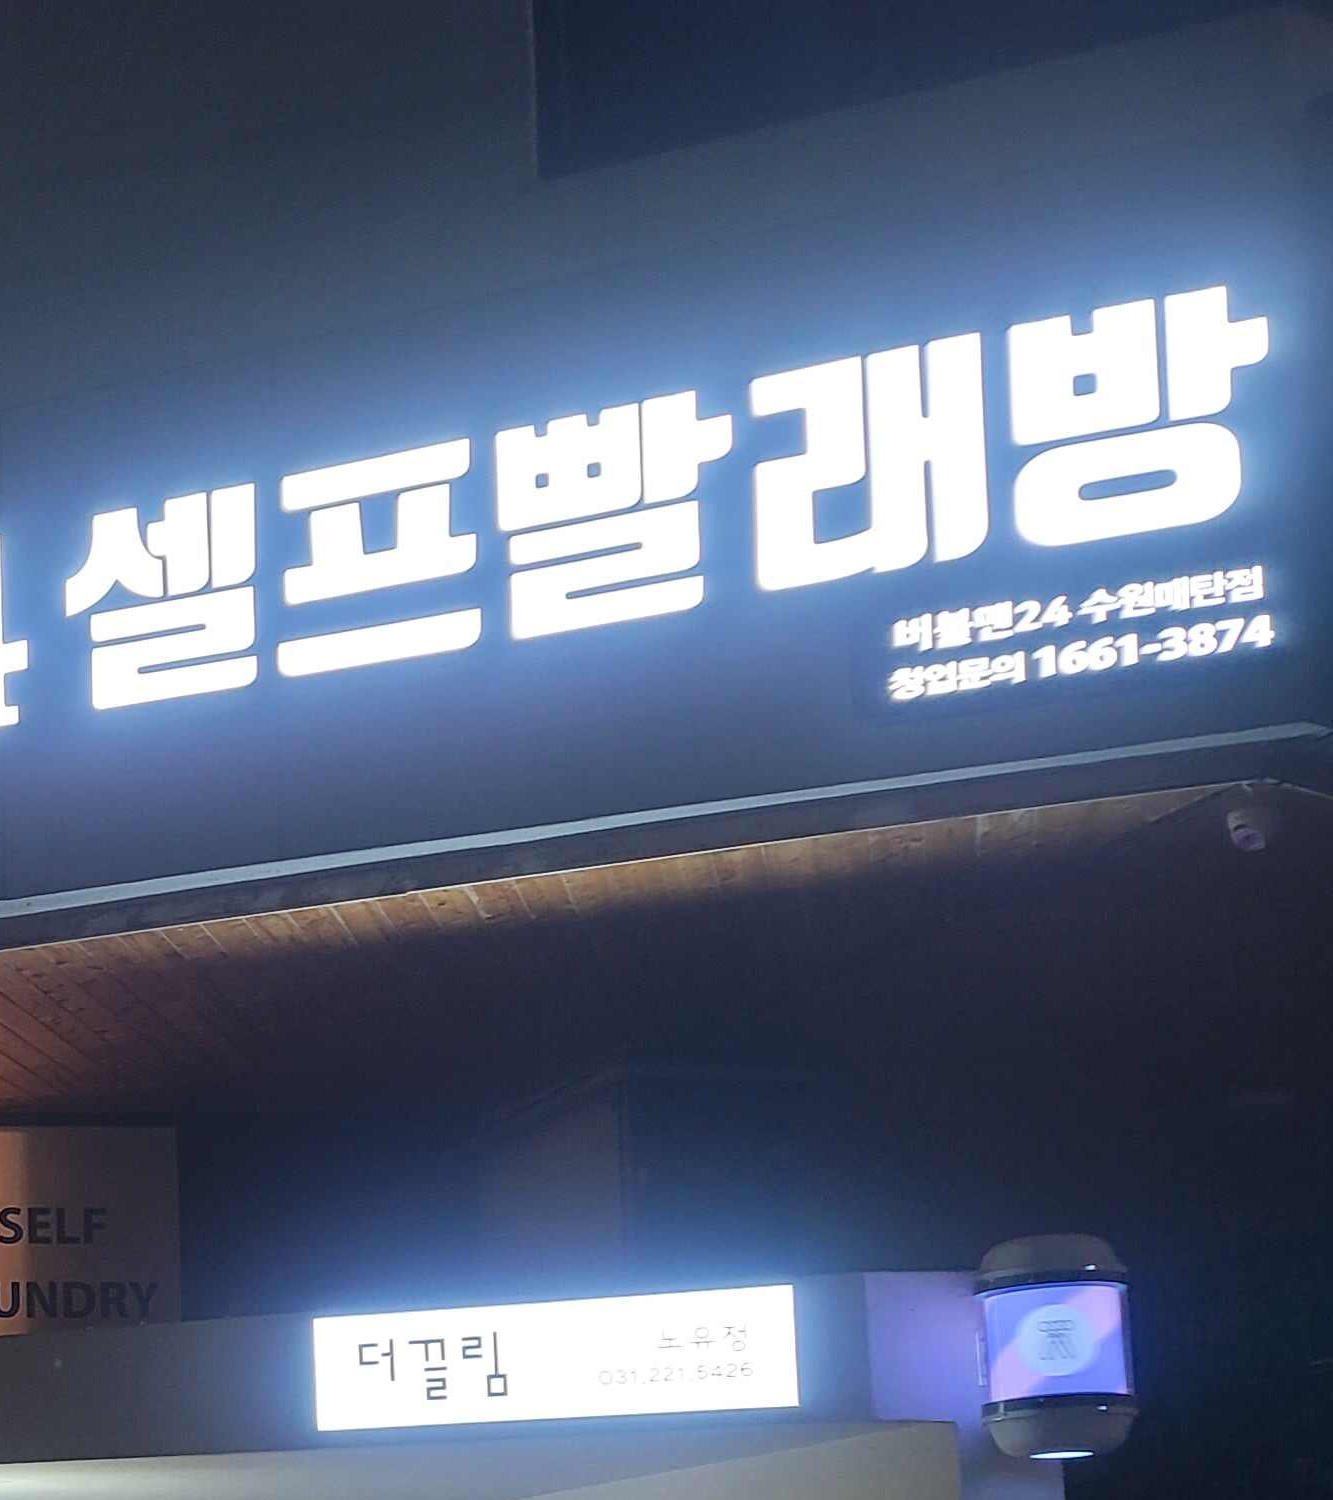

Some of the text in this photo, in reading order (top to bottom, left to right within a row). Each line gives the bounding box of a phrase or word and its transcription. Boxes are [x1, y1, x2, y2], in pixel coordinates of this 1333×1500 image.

[64, 285, 1271, 711] 셀프빨래방
[891, 565, 1264, 653] 버블맨24 수원매탄점
[887, 614, 1276, 701] 창업문의 1661-3874
